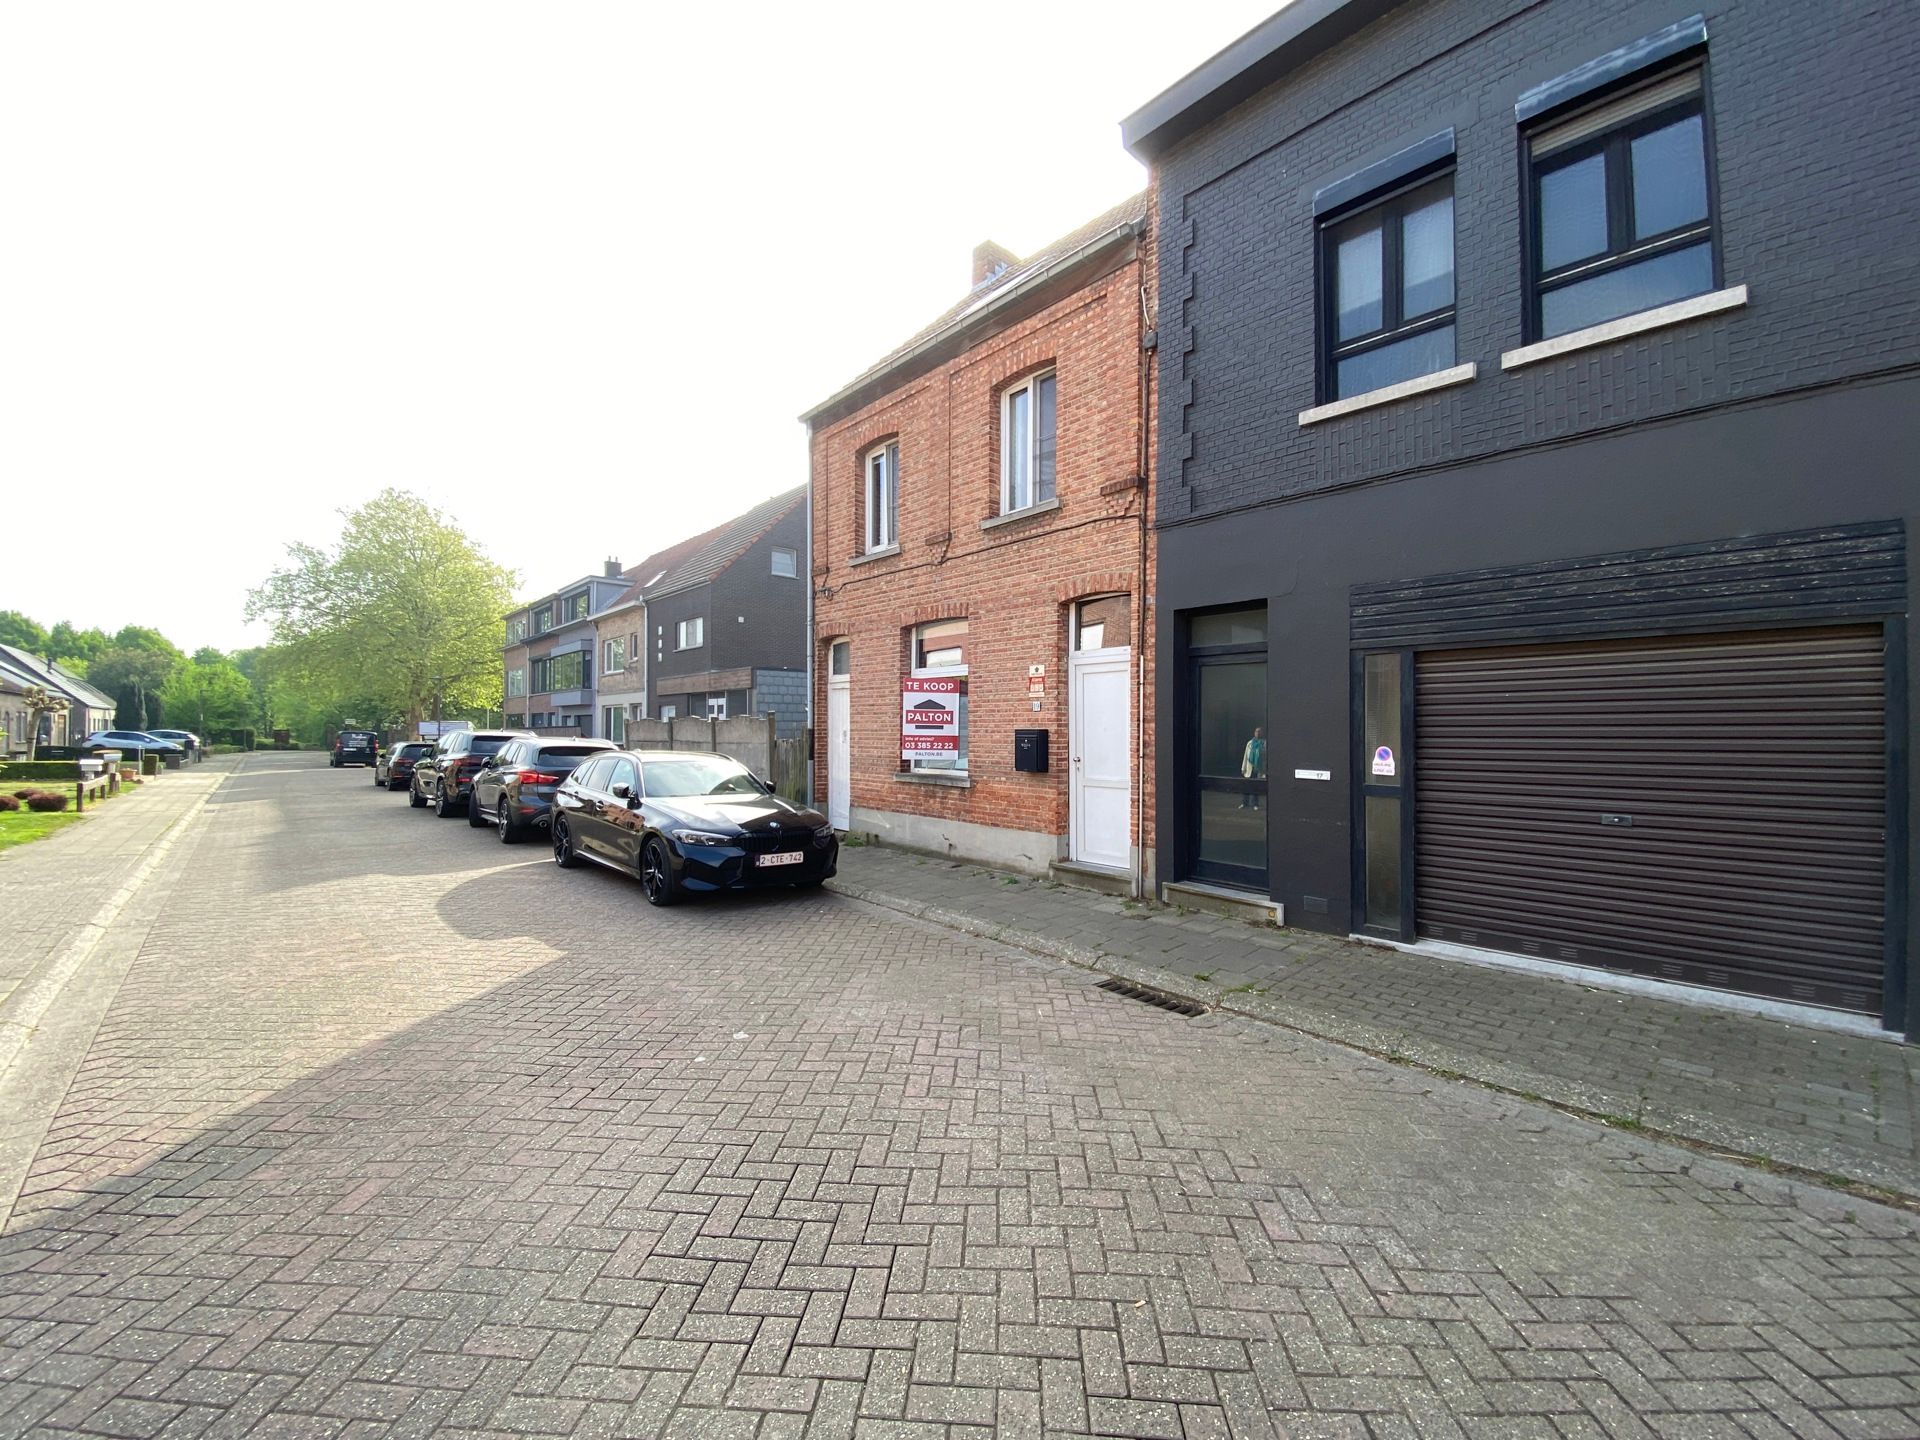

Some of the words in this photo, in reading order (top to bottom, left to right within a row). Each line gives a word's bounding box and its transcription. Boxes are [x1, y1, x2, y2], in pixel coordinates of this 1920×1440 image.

[906, 682, 920, 690] TE
[923, 682, 954, 691] KOOP
[907, 713, 951, 722] PALTON
